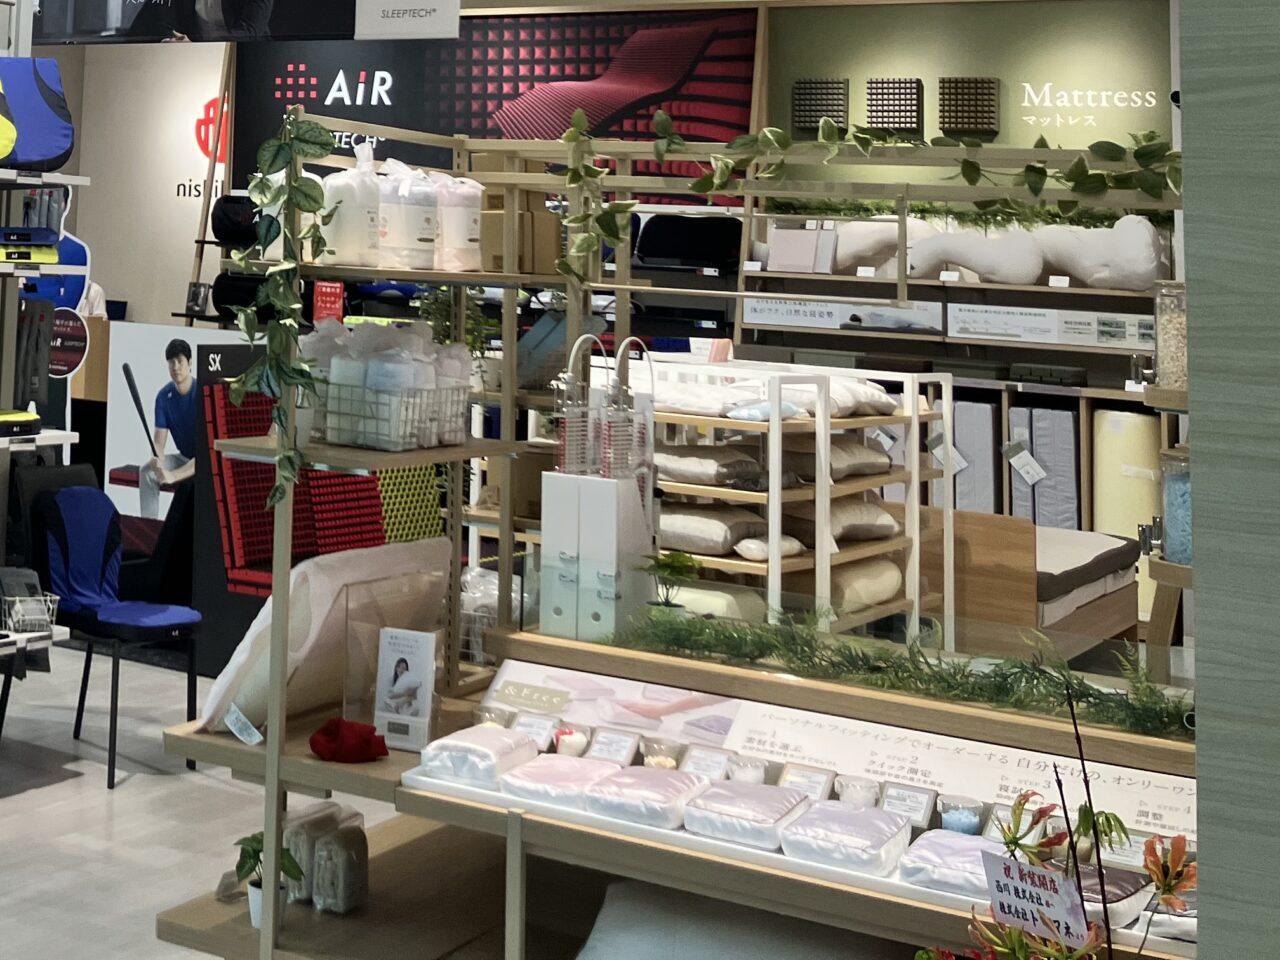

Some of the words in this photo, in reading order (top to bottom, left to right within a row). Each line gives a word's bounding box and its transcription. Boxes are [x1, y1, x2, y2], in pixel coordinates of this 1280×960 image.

[323, 68, 393, 106] AiR
[1020, 82, 1157, 108] Mattress
[1021, 113, 1097, 127] マットレス
[208, 353, 222, 372] SX
[909, 754, 919, 764] 2
[1042, 779, 1052, 790] 3
[1183, 805, 1191, 815] 4
